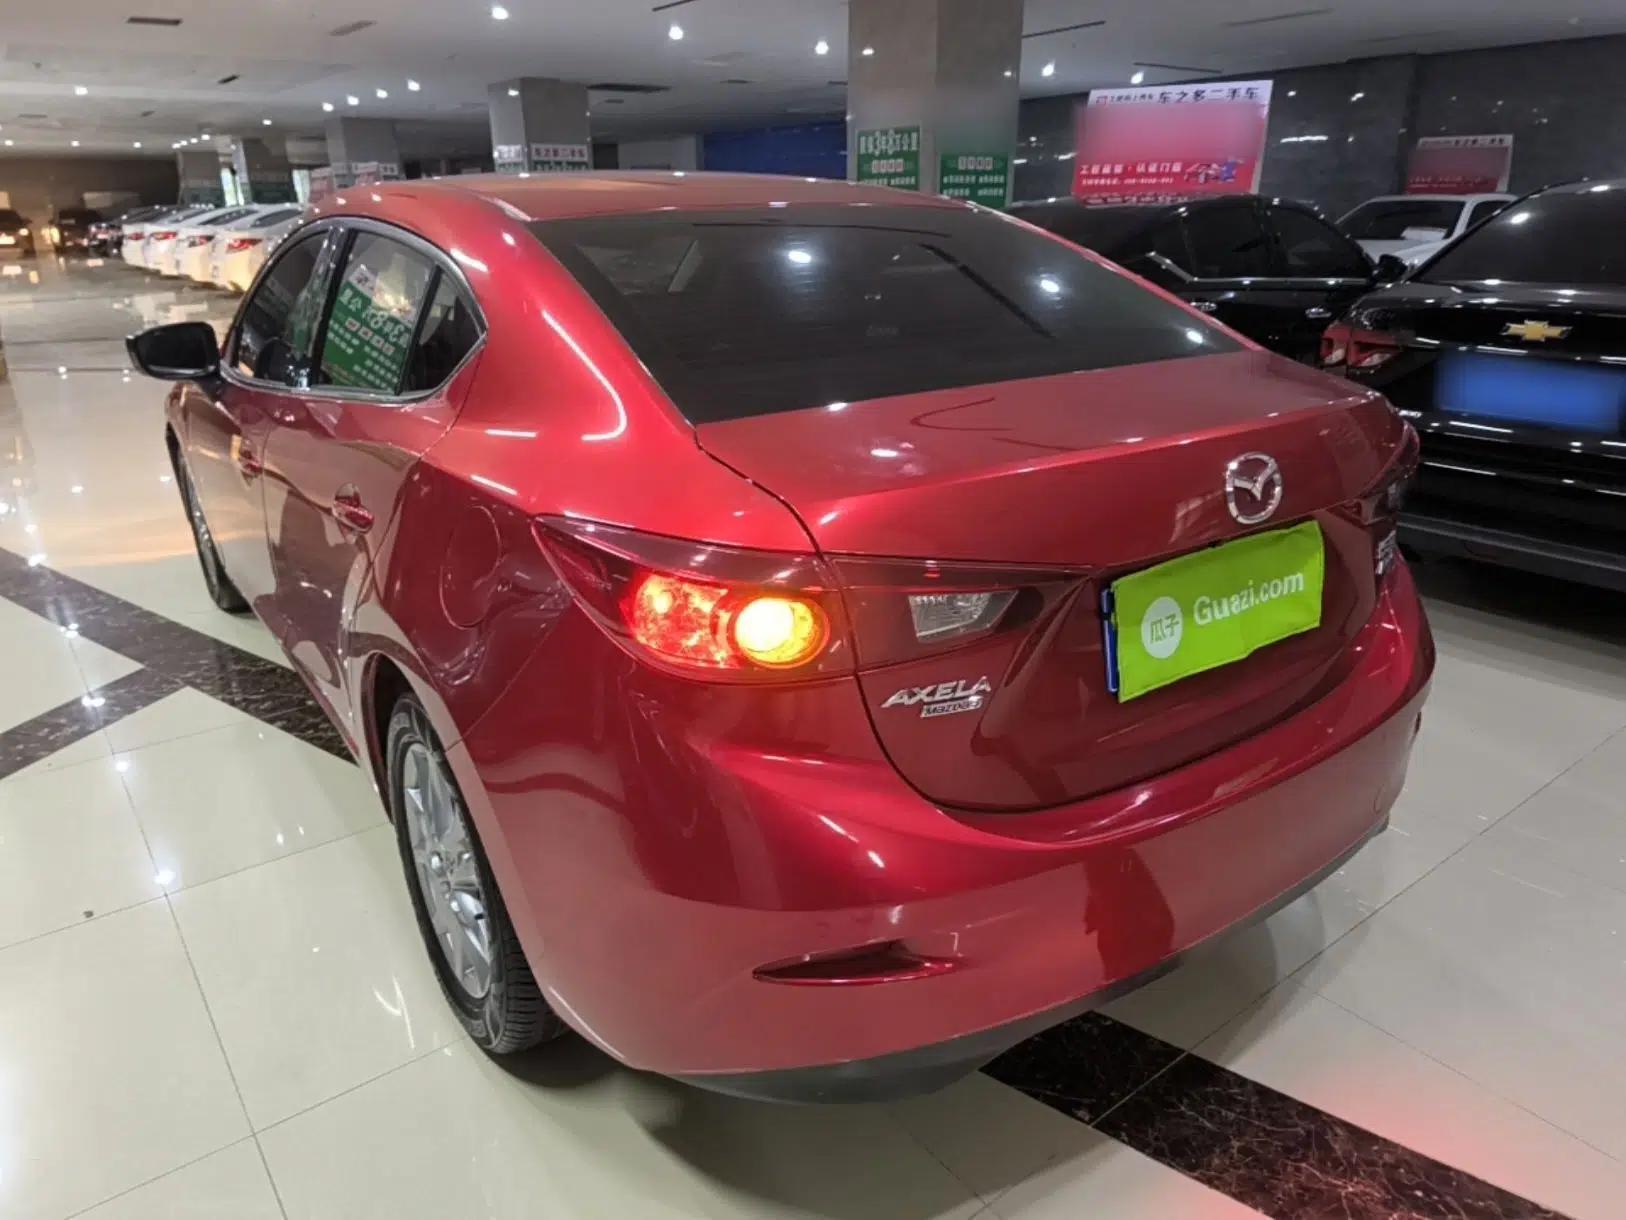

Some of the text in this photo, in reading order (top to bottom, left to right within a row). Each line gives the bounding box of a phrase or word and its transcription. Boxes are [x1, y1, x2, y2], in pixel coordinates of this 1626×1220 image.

[1193, 572, 1304, 625] Guazi.com
[1150, 613, 1180, 642] 瓜子
[881, 676, 991, 708] AXELA
